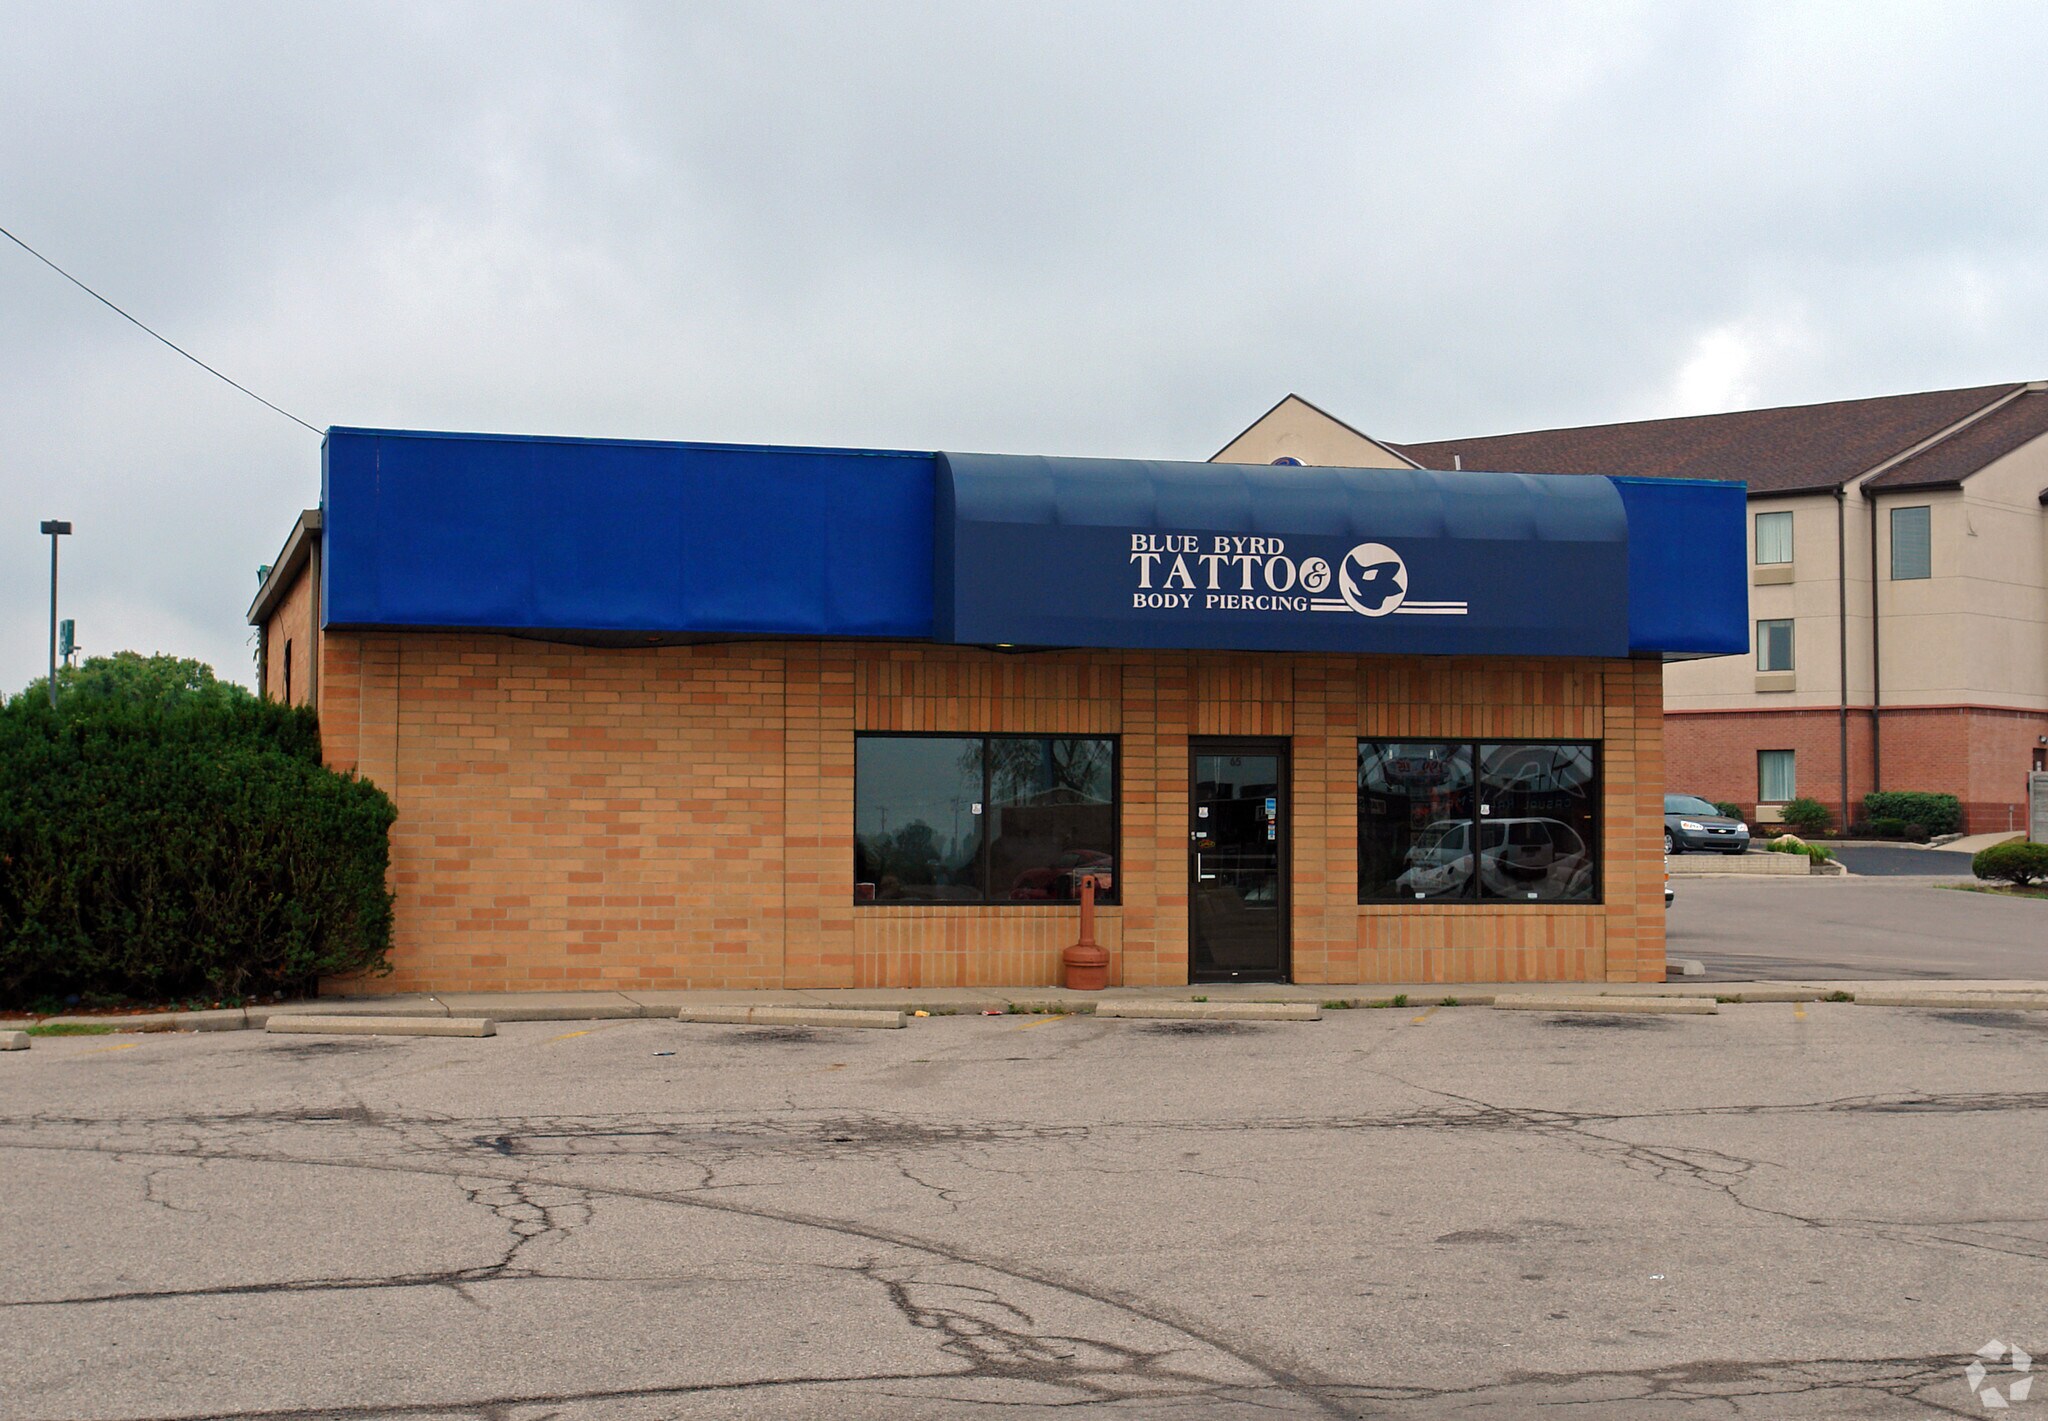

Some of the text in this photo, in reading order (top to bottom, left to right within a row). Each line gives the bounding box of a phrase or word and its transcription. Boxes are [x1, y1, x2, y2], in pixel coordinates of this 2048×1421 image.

[1130, 533, 1285, 556] BLUE BYRD
[1132, 592, 1308, 612] BODY PIERCING
[1230, 756, 1242, 767] 65
